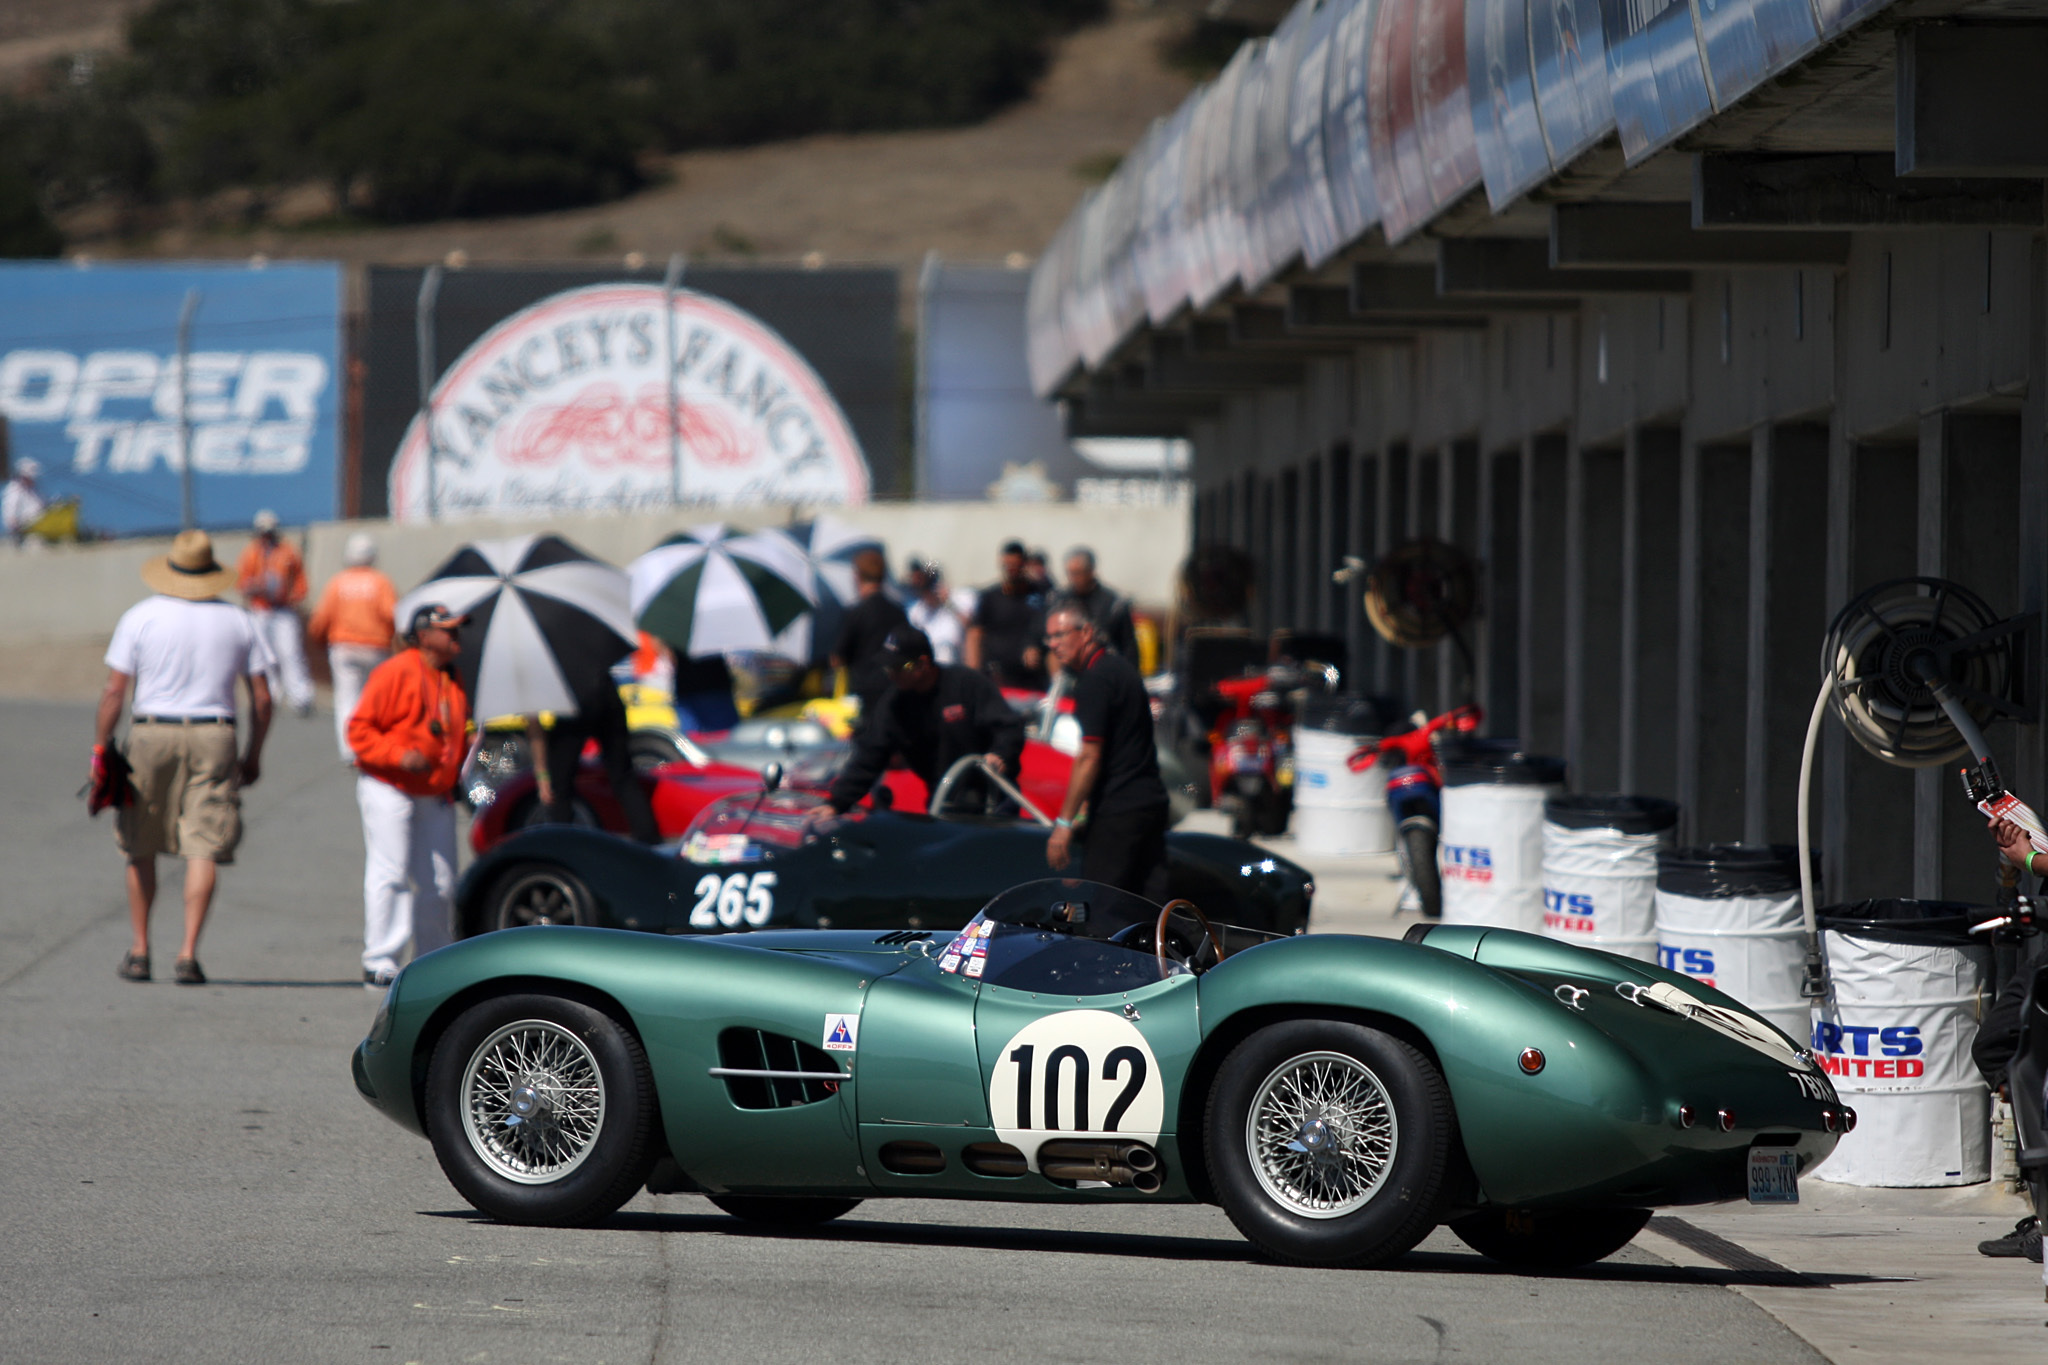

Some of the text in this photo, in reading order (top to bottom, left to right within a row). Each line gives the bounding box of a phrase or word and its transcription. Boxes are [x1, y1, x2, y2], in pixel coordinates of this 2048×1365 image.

[0, 350, 329, 423] OPER
[432, 310, 829, 477] YANCEY'S FANCY
[65, 420, 314, 474] TIRES
[1443, 844, 1492, 867] TS
[689, 870, 778, 927] 265
[1543, 887, 1595, 916] TS
[1656, 942, 1715, 974] TS
[1811, 1021, 1923, 1057] RTS
[1010, 1044, 1147, 1132] 102
